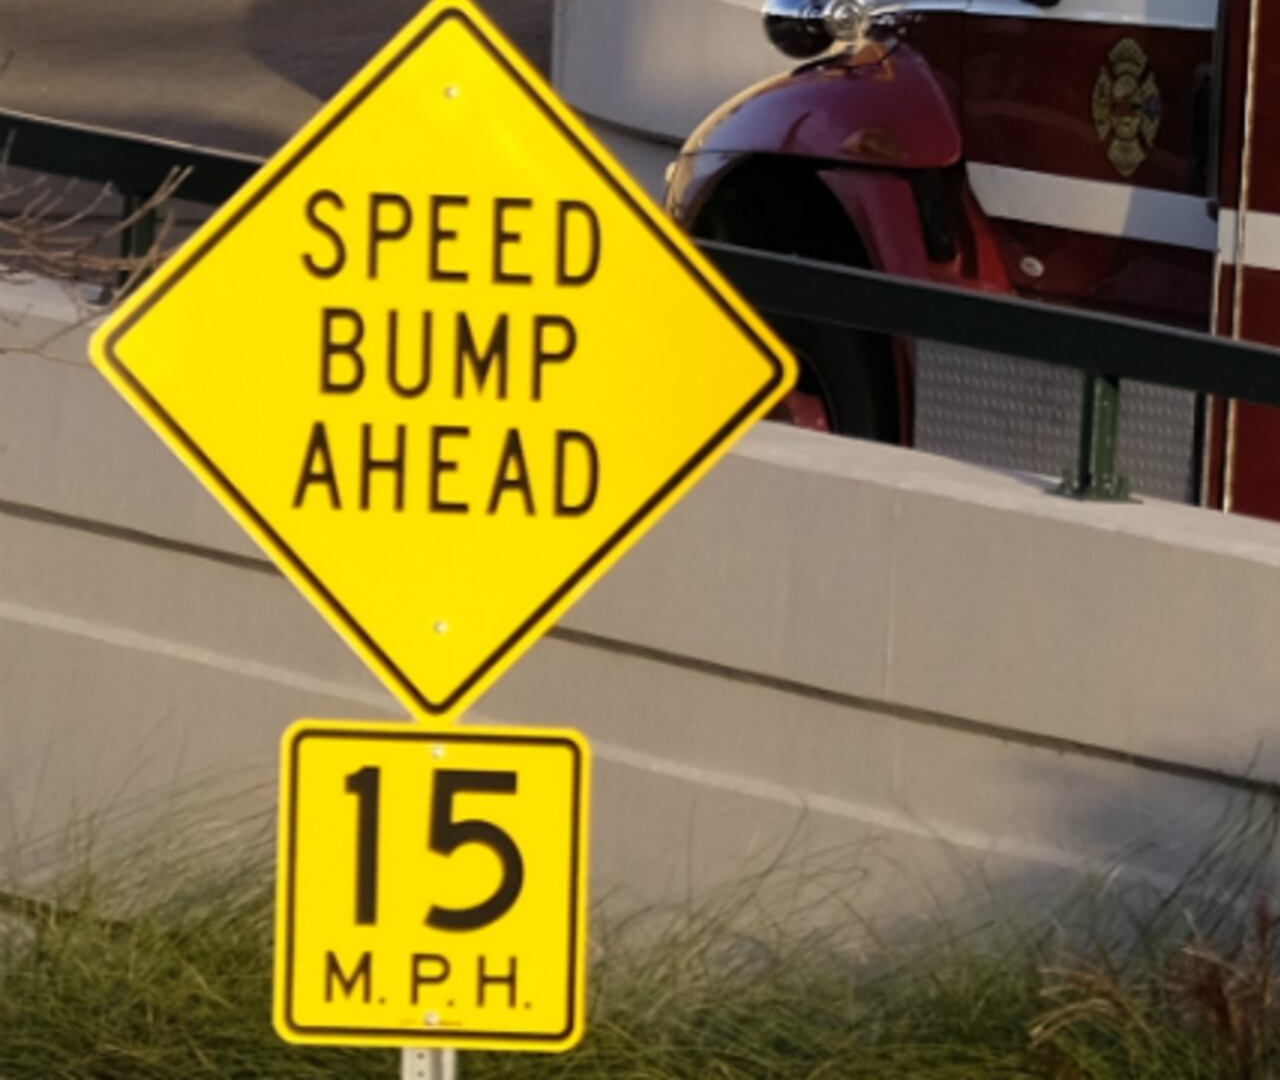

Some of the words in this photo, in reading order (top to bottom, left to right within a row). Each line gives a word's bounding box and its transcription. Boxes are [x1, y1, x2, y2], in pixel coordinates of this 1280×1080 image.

[300, 189, 603, 288] SPEED
[318, 307, 579, 402] BUMP
[291, 421, 602, 518] AHEAD
[344, 765, 526, 934] 15
[323, 950, 533, 1011] M.P.H.
